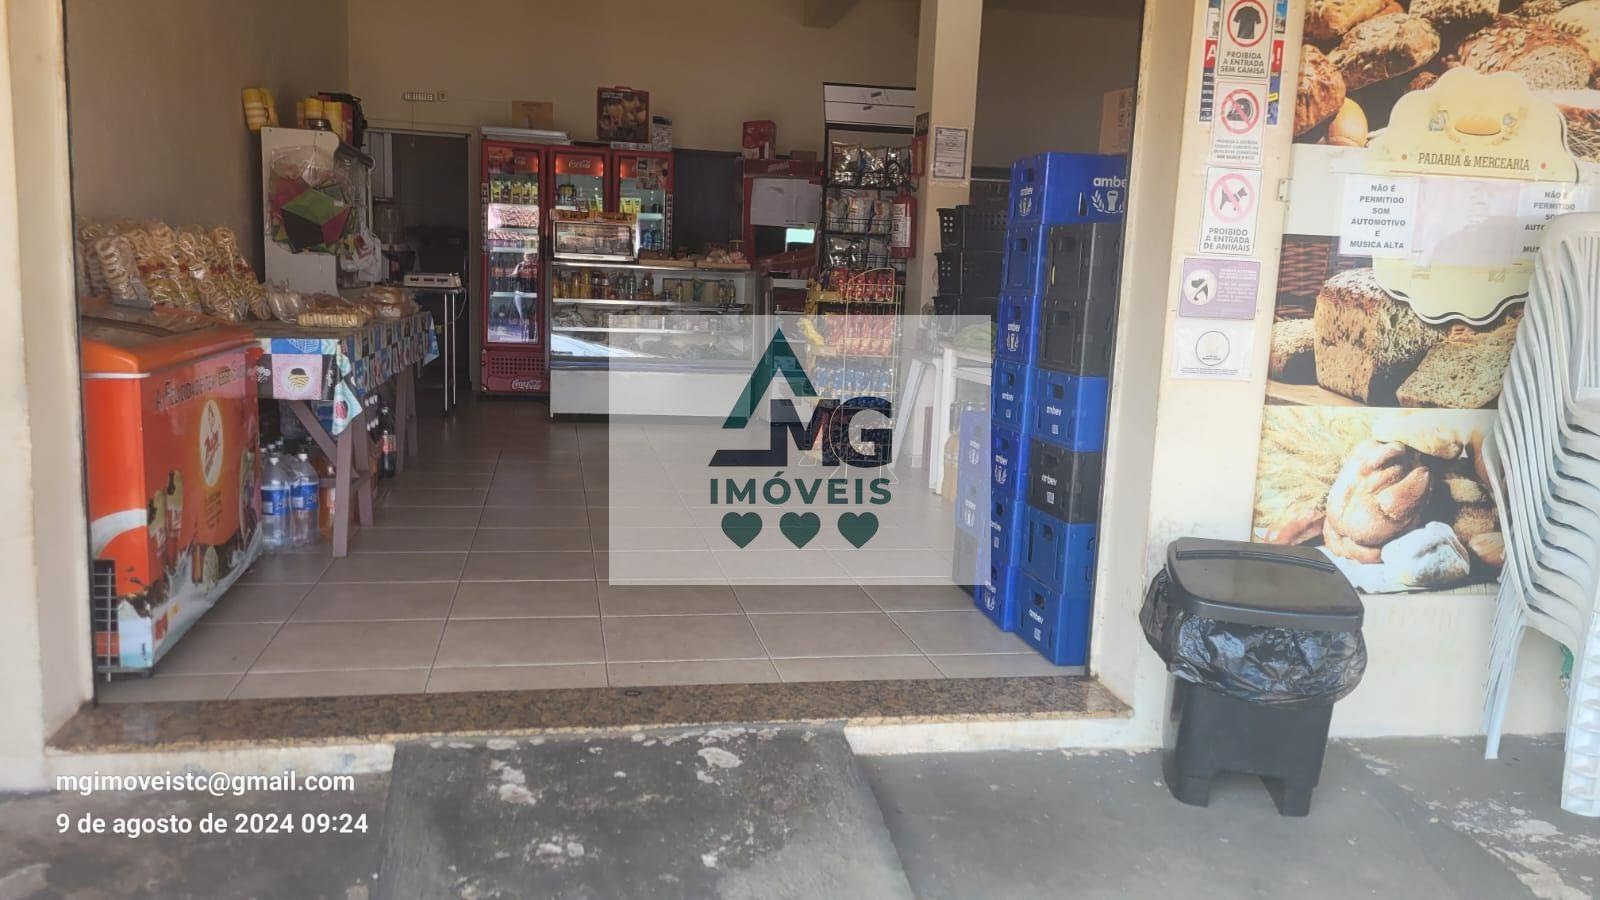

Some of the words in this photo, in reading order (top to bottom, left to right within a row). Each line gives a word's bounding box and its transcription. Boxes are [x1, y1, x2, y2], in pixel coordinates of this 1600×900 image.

[1226, 51, 1262, 59] PROIBIDA
[1219, 65, 1236, 73] SEM
[1237, 66, 1265, 74] CAMISA
[1418, 152, 1461, 167] PADARIA
[1463, 154, 1471, 167] &
[1473, 155, 1530, 171] MERCEARIA
[1370, 183, 1388, 193] NÃO
[1390, 184, 1396, 192] É
[1544, 190, 1561, 199] NÃO
[1359, 195, 1404, 204] PERMITIDO
[1372, 207, 1390, 215] SOM
[1351, 218, 1406, 227] AUTOMOTIVO
[1208, 227, 1248, 237] PROIBIDO
[1213, 235, 1250, 244] ENTRADA
[1203, 242, 1215, 250] DE
[1216, 243, 1250, 252] ANIMAIS
[1350, 240, 1381, 248] MUSICA
[1383, 241, 1404, 249] ALTA
